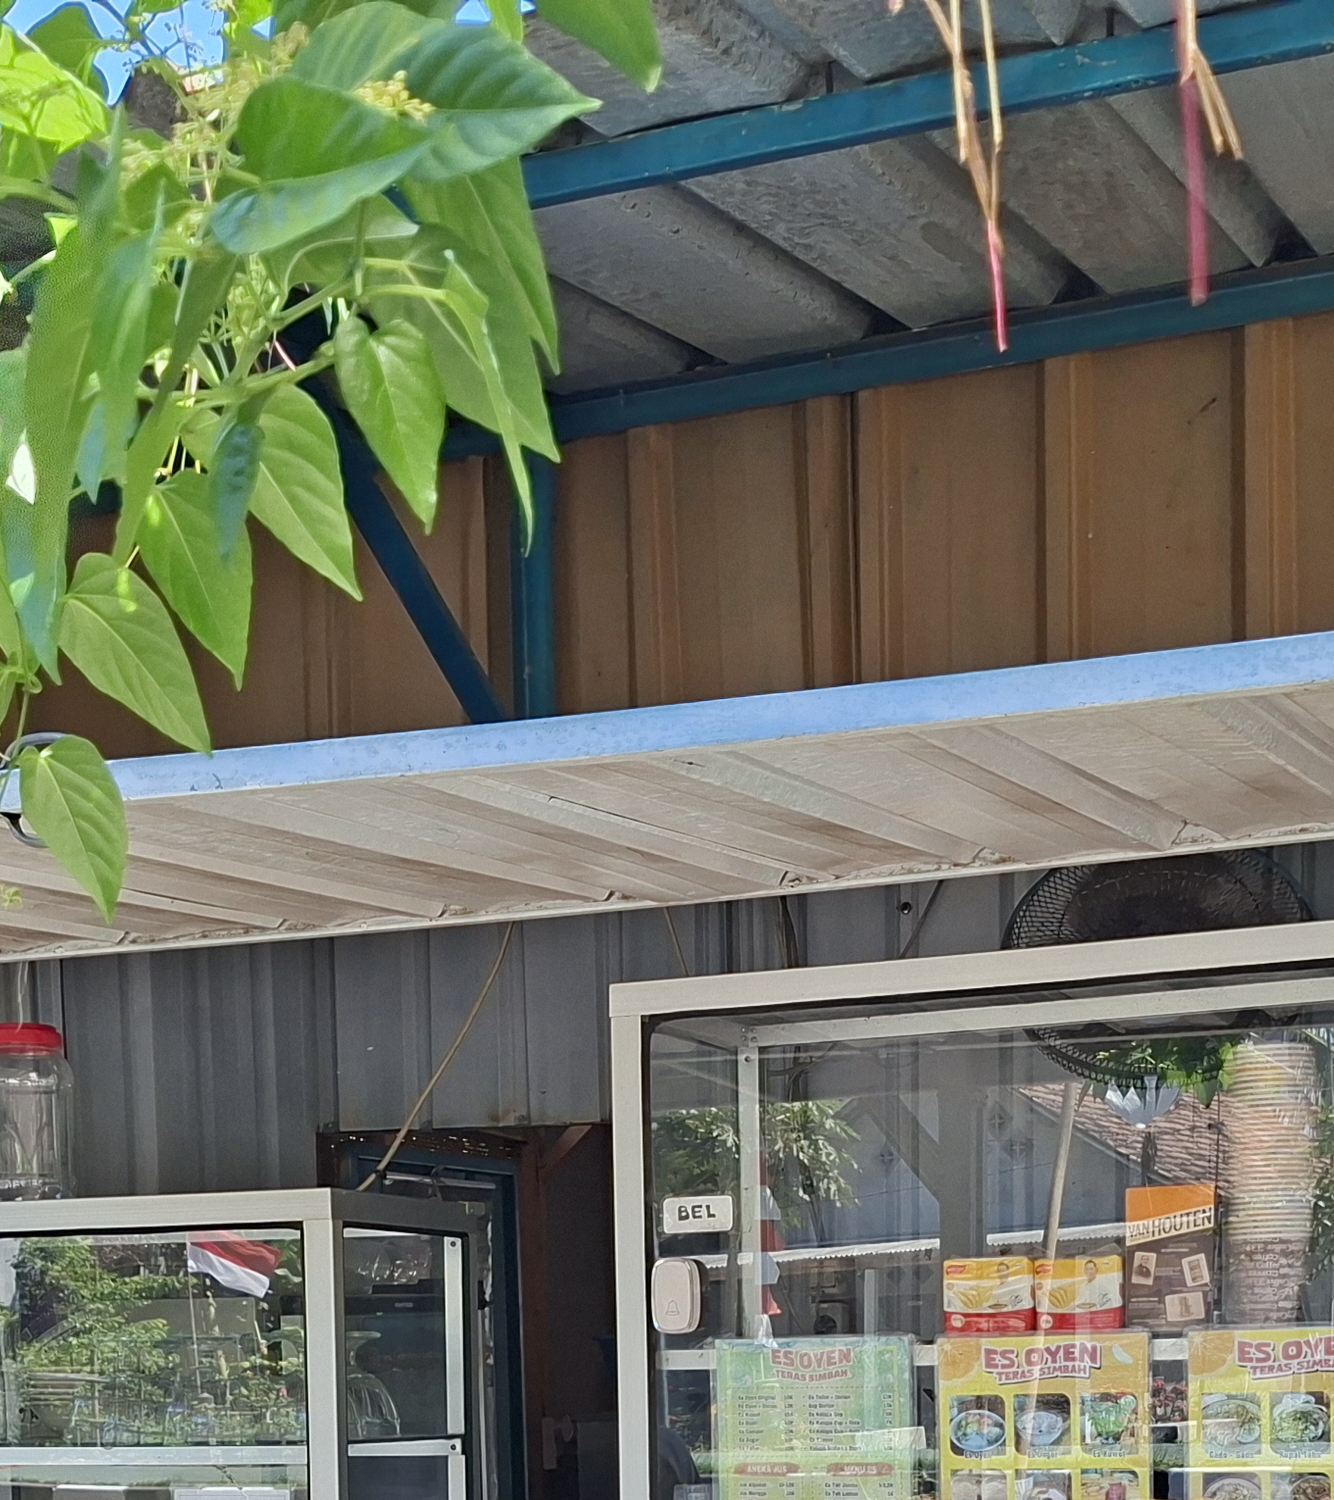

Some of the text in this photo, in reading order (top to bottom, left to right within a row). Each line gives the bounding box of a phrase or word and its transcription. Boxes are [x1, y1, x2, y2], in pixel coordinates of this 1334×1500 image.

[678, 1204, 716, 1221] BEL
[1127, 1207, 1212, 1238] VAN HOUTEN
[770, 1347, 853, 1370] ES OYEN
[983, 1342, 1100, 1370] ES OYEN
[1237, 1340, 1272, 1364] ES
[775, 1369, 849, 1383] TERAS SIMBAH
[996, 1364, 1088, 1382] TERAS SIMBAH
[1249, 1364, 1292, 1376] TERAS
